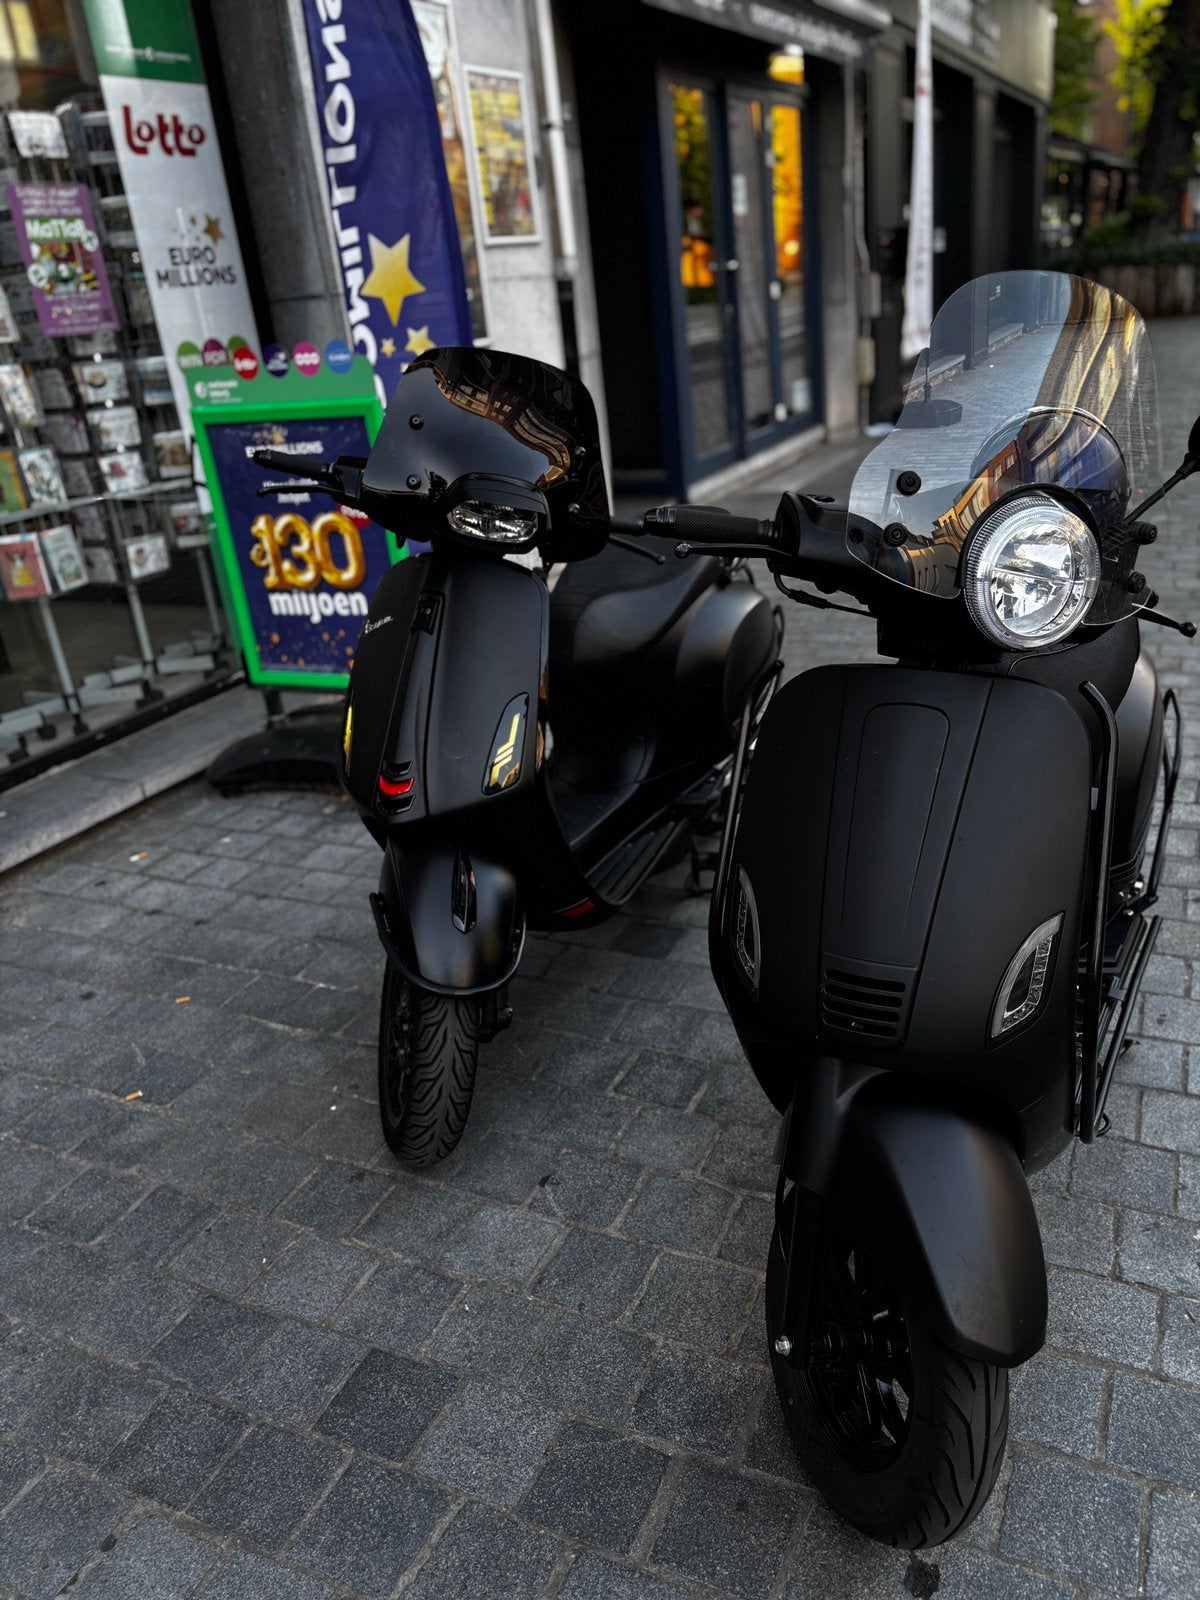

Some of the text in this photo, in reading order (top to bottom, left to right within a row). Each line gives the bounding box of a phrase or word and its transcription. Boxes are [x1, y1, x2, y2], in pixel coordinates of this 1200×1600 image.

[169, 247, 217, 266] EURO
[156, 266, 237, 289] MILLIONS
[268, 590, 368, 624] miljoen
